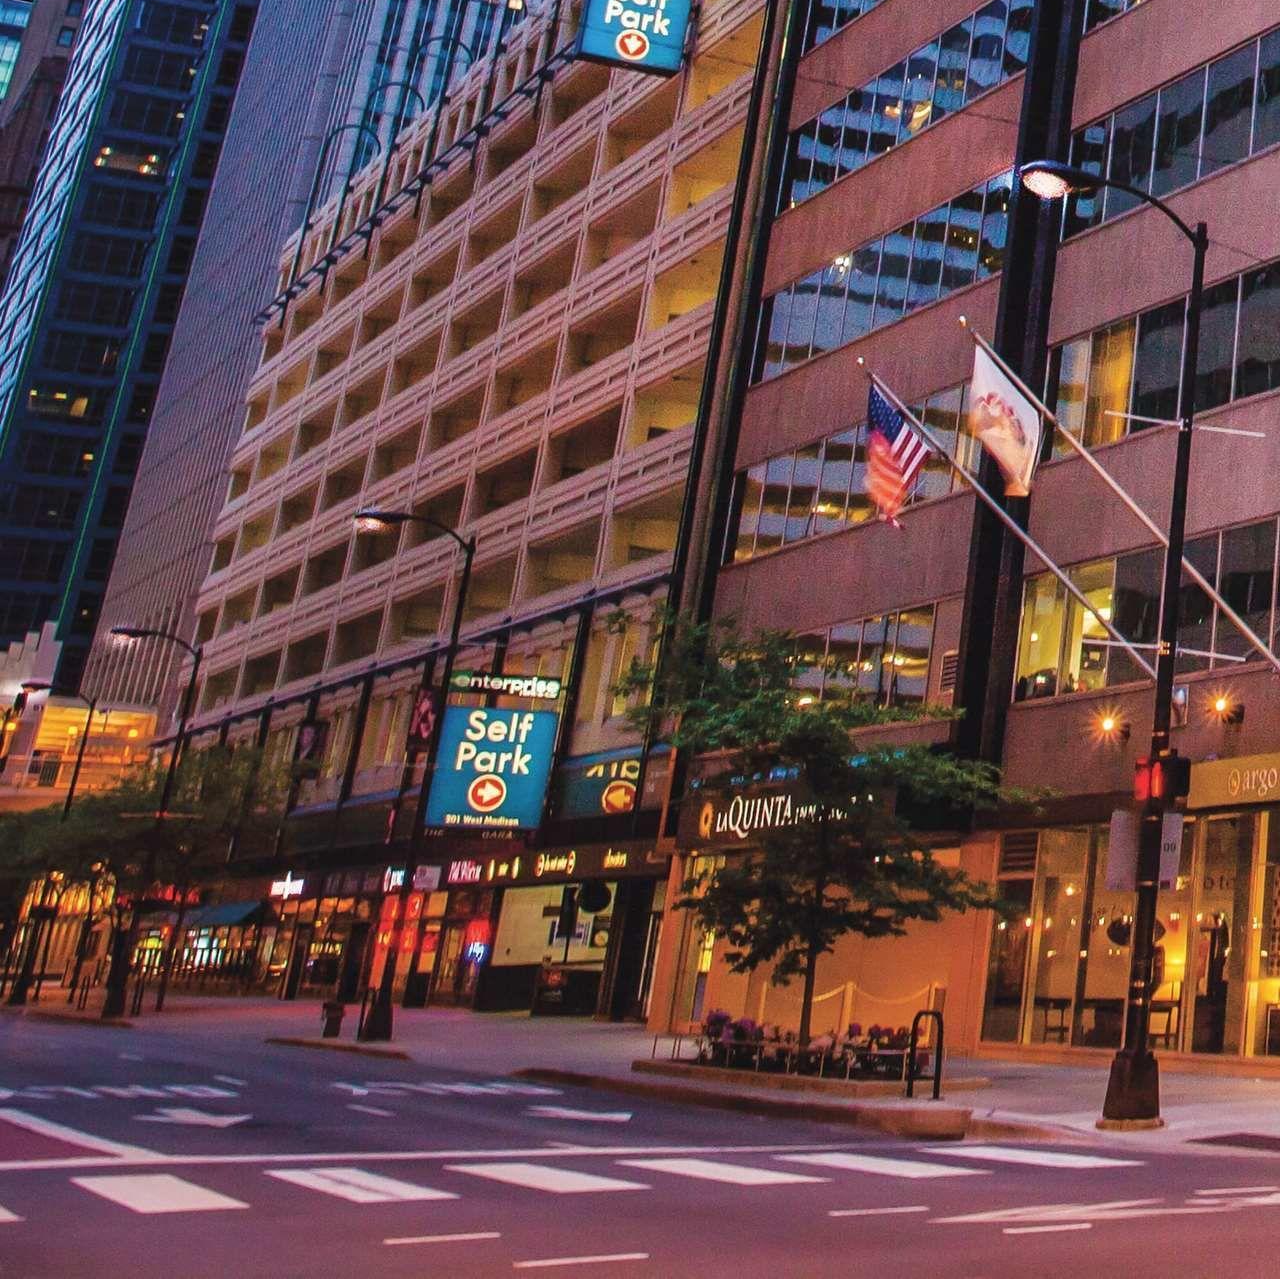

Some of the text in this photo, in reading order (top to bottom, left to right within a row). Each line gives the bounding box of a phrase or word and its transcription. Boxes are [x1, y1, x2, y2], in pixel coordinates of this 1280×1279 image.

[604, 0, 670, 36] Park
[465, 710, 534, 743] Self
[455, 742, 532, 775] Park
[1243, 767, 1278, 797] argo
[729, 794, 793, 839] QUINTA
